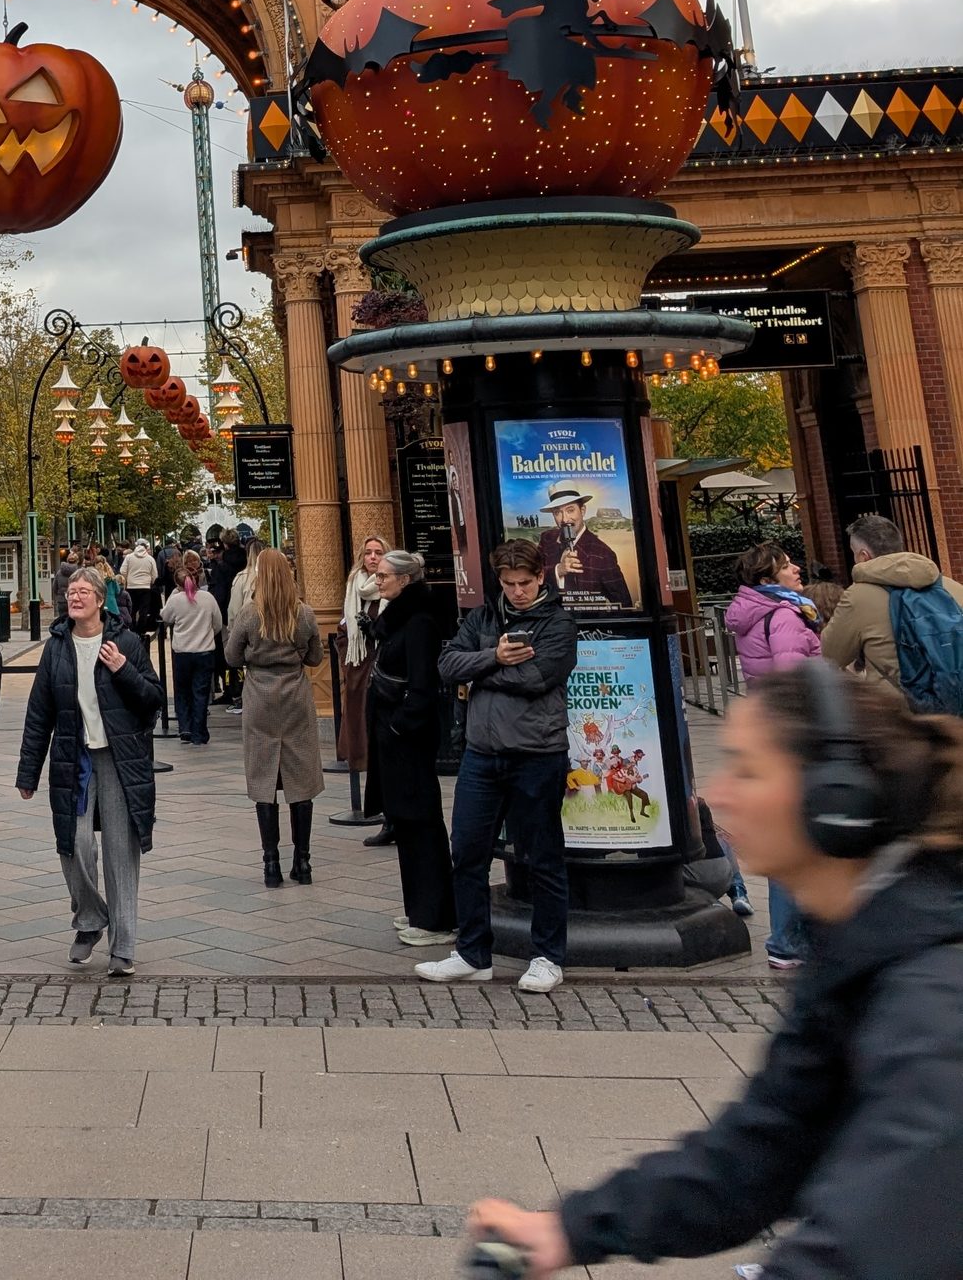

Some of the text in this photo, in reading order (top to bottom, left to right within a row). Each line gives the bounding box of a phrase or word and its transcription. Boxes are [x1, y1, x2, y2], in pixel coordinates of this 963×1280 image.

[744, 307, 770, 317] eller
[765, 316, 823, 328] Tivolikort
[548, 429, 577, 438] TIVOLI
[541, 443, 585, 451] TONER FRA
[511, 452, 616, 473] Badehotellet
[569, 671, 619, 684] YRENE I
[566, 684, 634, 697] KKEBKKE
